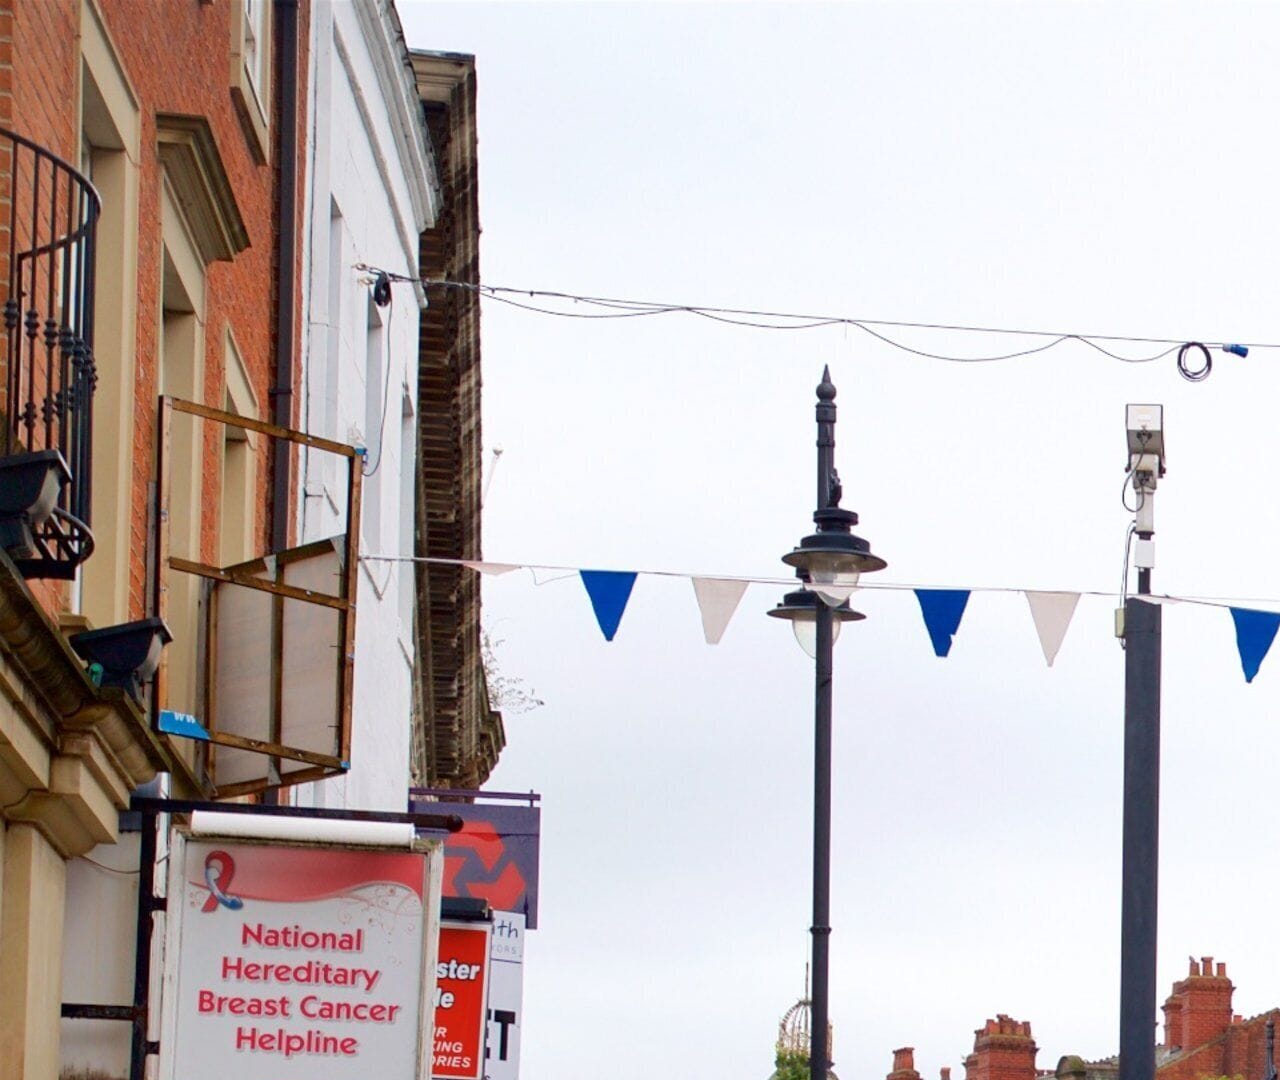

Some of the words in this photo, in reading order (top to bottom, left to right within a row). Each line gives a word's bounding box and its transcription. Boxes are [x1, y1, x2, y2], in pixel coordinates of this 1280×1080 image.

[241, 922, 363, 951] National
[221, 956, 379, 991] Hereditary
[198, 990, 290, 1016] Breast
[299, 995, 400, 1021] Cancer
[236, 1027, 358, 1056] Helpline
